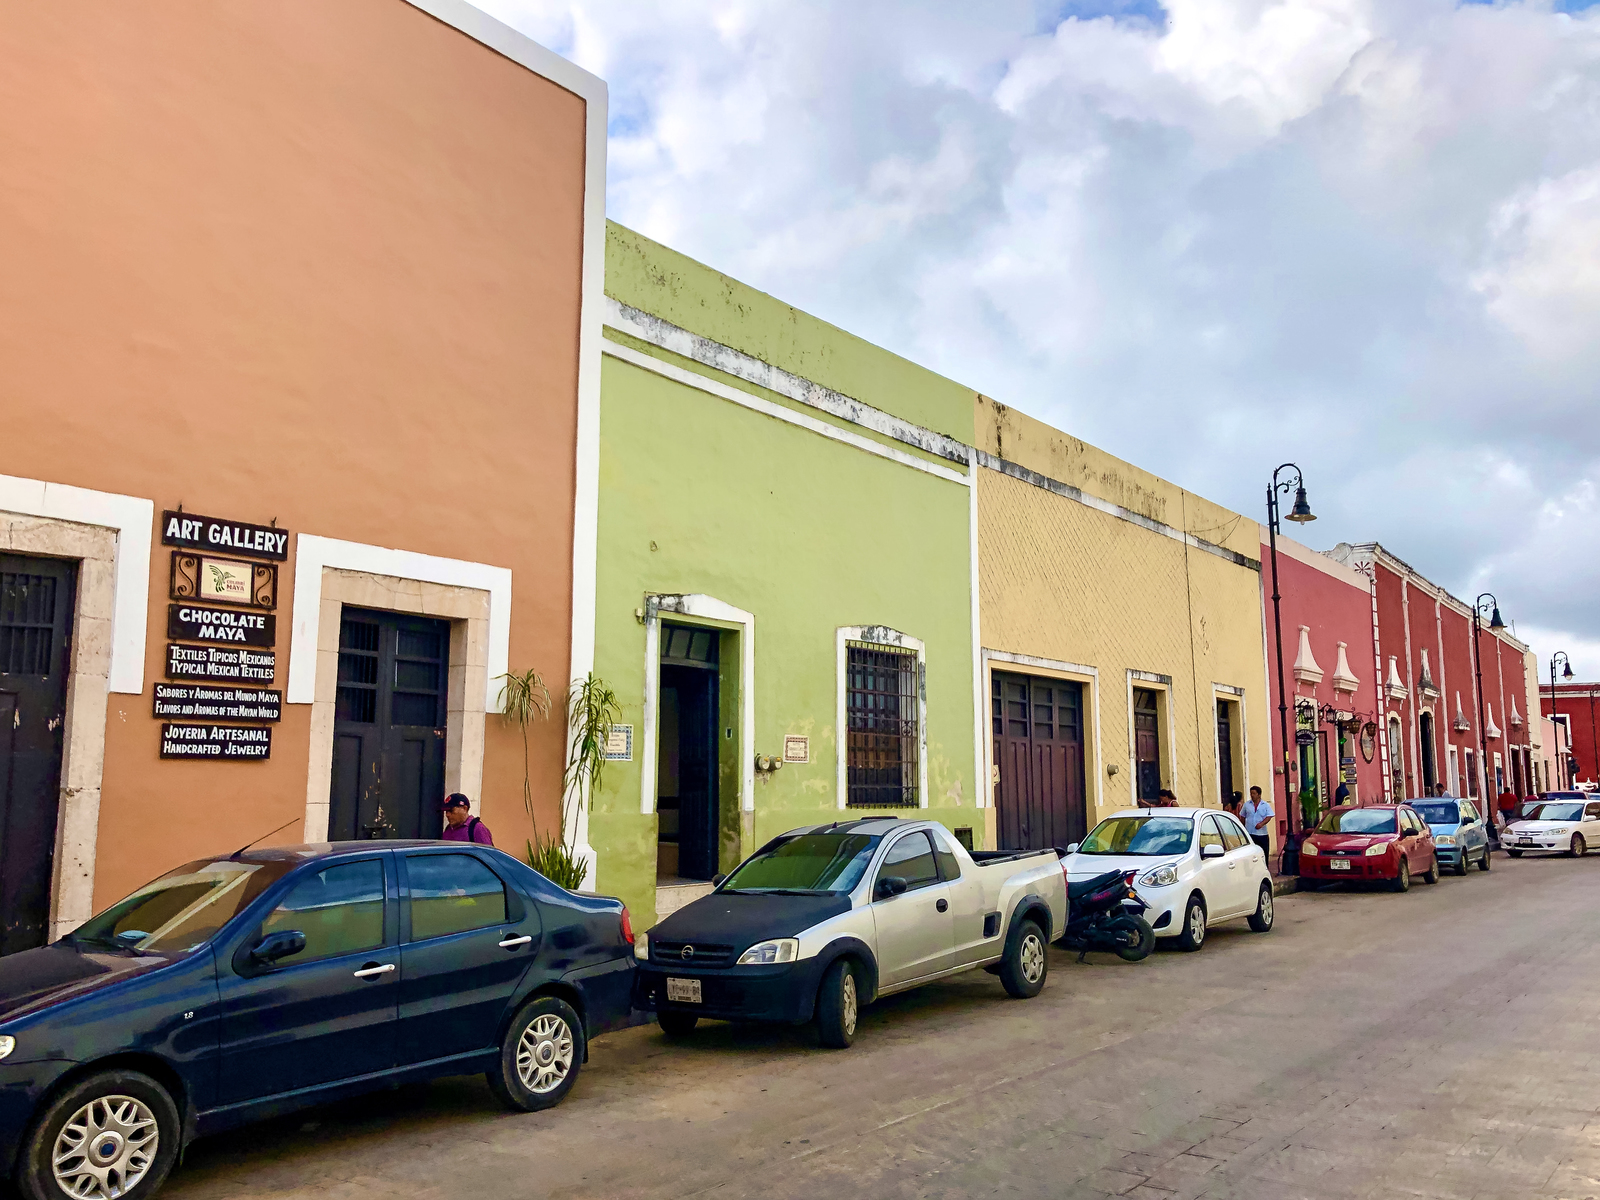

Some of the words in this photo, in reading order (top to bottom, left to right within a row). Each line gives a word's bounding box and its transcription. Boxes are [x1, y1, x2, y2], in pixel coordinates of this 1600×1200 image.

[166, 517, 203, 541] ART
[208, 523, 287, 554] GALLERY
[226, 584, 245, 592] MAYA
[179, 608, 265, 629] CHOCOLATE
[198, 624, 246, 642] MAYA
[170, 645, 207, 661] TEXTILES
[238, 650, 275, 666] MEXICANOS
[170, 659, 205, 675] TYPICAL
[206, 662, 240, 677] MEXICAN
[240, 664, 274, 679] TEXTILES
[156, 685, 188, 699] SABORES
[194, 687, 223, 700] AROMAS
[223, 691, 234, 701] DEL
[234, 689, 257, 702] MUNDO
[257, 691, 279, 704] MAYA
[155, 701, 181, 715] FLAVORS
[181, 704, 194, 714] AND
[193, 703, 218, 716] AROMAS
[218, 707, 226, 716] OF
[226, 707, 239, 716] THE
[238, 705, 258, 718] MAYAN
[258, 706, 279, 719] WORLD
[165, 724, 207, 740] JOYERIA
[209, 726, 269, 742] ARTESANAL
[163, 741, 221, 755] HANDCRAFTED
[224, 741, 268, 755] JEWELRY
